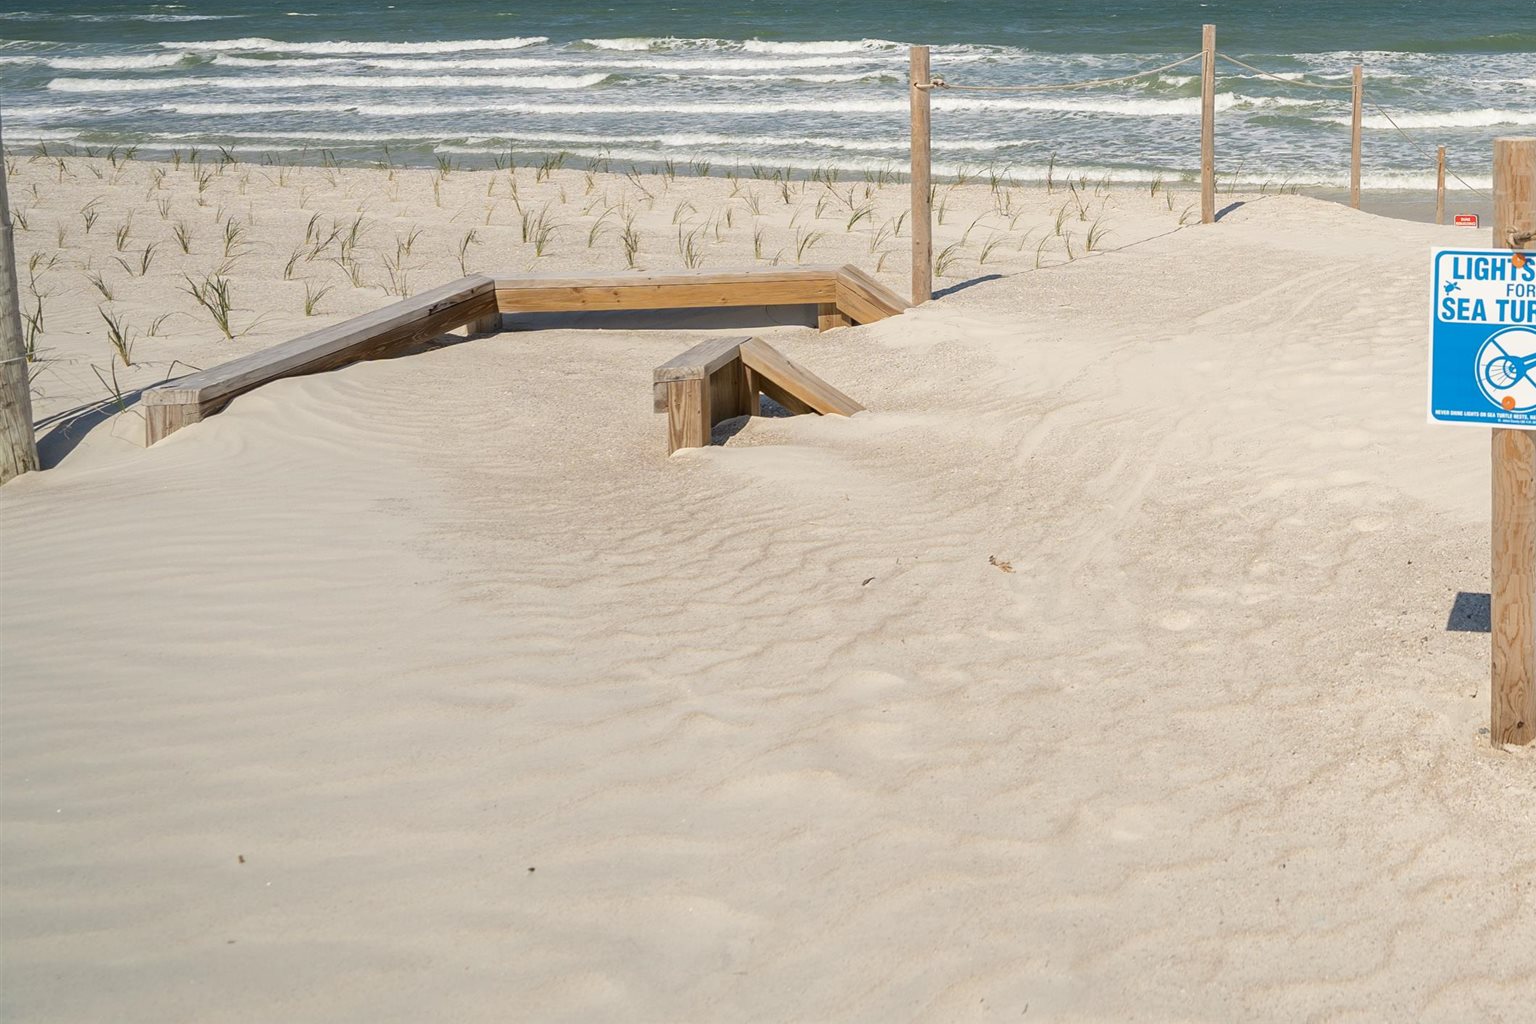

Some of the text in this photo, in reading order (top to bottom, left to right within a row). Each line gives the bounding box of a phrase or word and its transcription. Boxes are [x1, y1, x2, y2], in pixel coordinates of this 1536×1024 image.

[1453, 257, 1535, 282] LIGHTS
[1507, 284, 1536, 297] FOR
[1442, 297, 1486, 321] SEA
